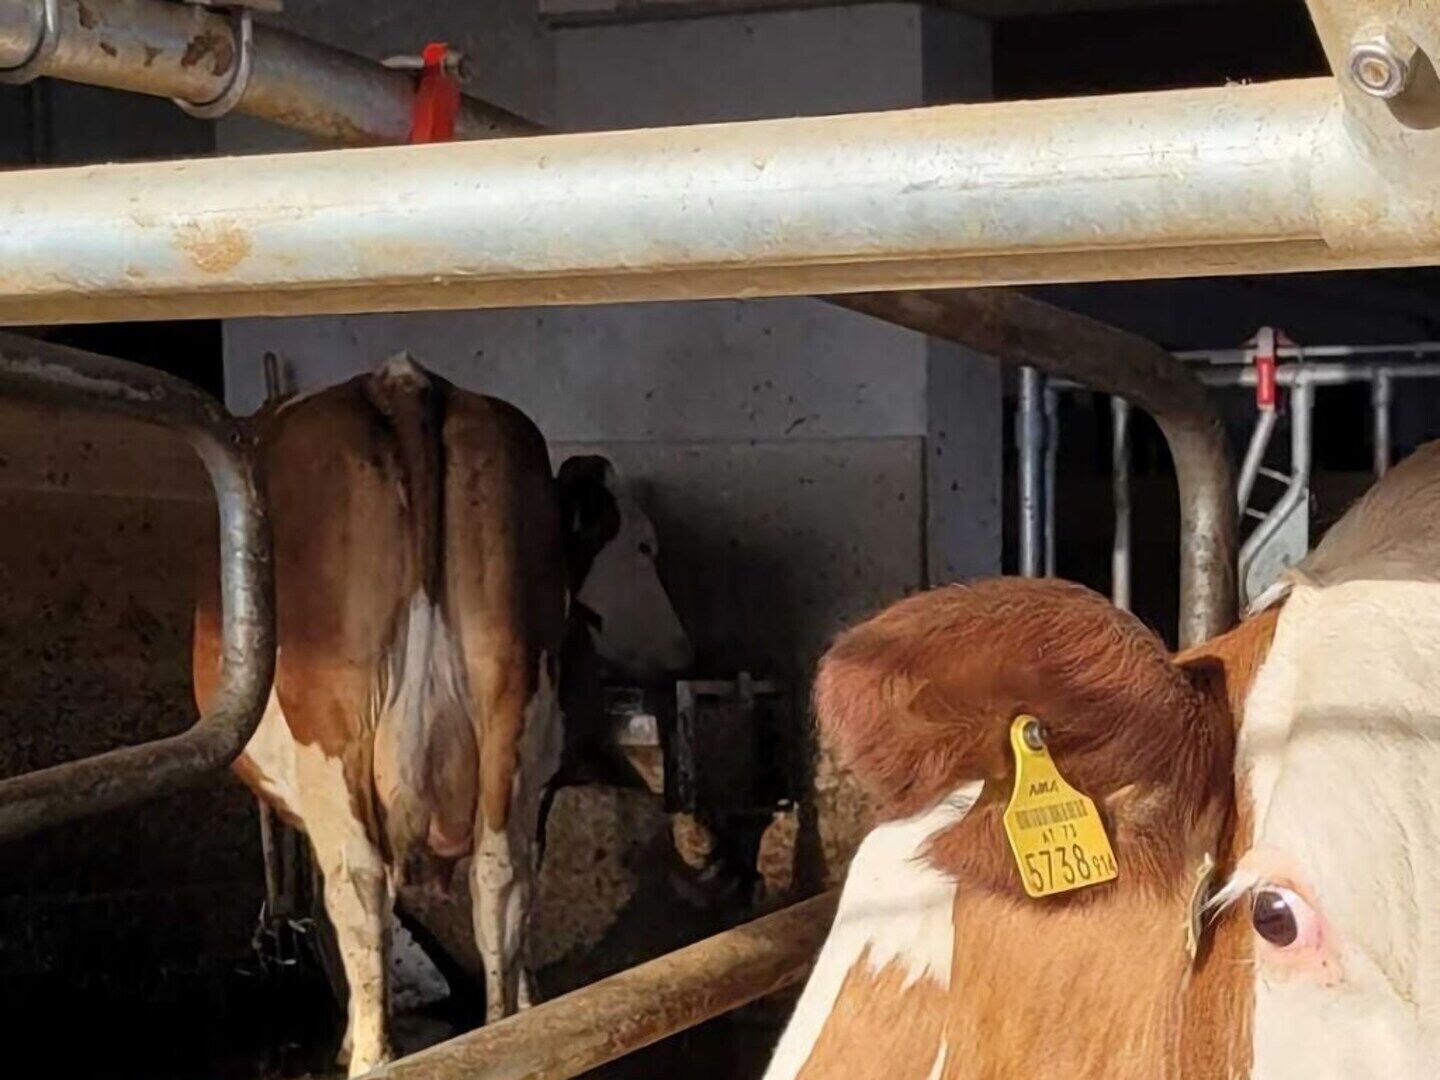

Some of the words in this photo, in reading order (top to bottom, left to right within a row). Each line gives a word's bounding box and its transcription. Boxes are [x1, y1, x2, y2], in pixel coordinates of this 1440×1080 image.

[1042, 829, 1054, 844] AT
[1063, 823, 1077, 841] 73
[1025, 843, 1091, 893] 5738
